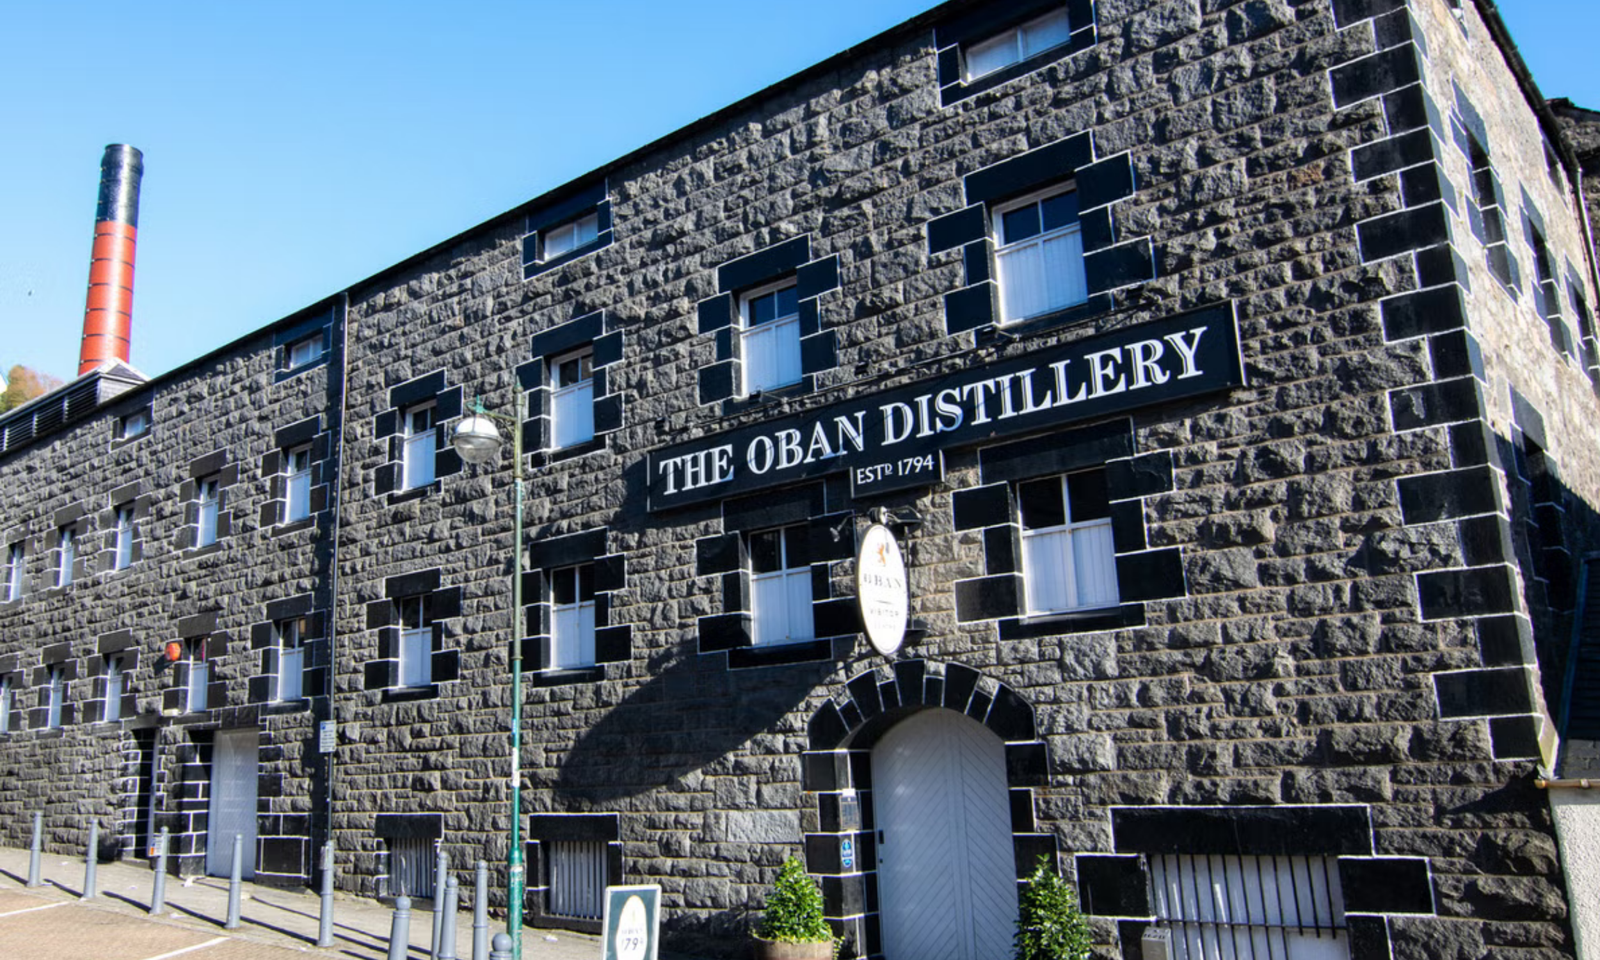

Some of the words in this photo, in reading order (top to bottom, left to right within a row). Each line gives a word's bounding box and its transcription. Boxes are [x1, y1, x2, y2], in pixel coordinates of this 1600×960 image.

[658, 444, 735, 496] THE
[747, 410, 865, 475] OBAN
[880, 327, 1208, 446] DISTILLERY
[898, 454, 935, 477] 1794
[863, 573, 902, 589] OBAN
